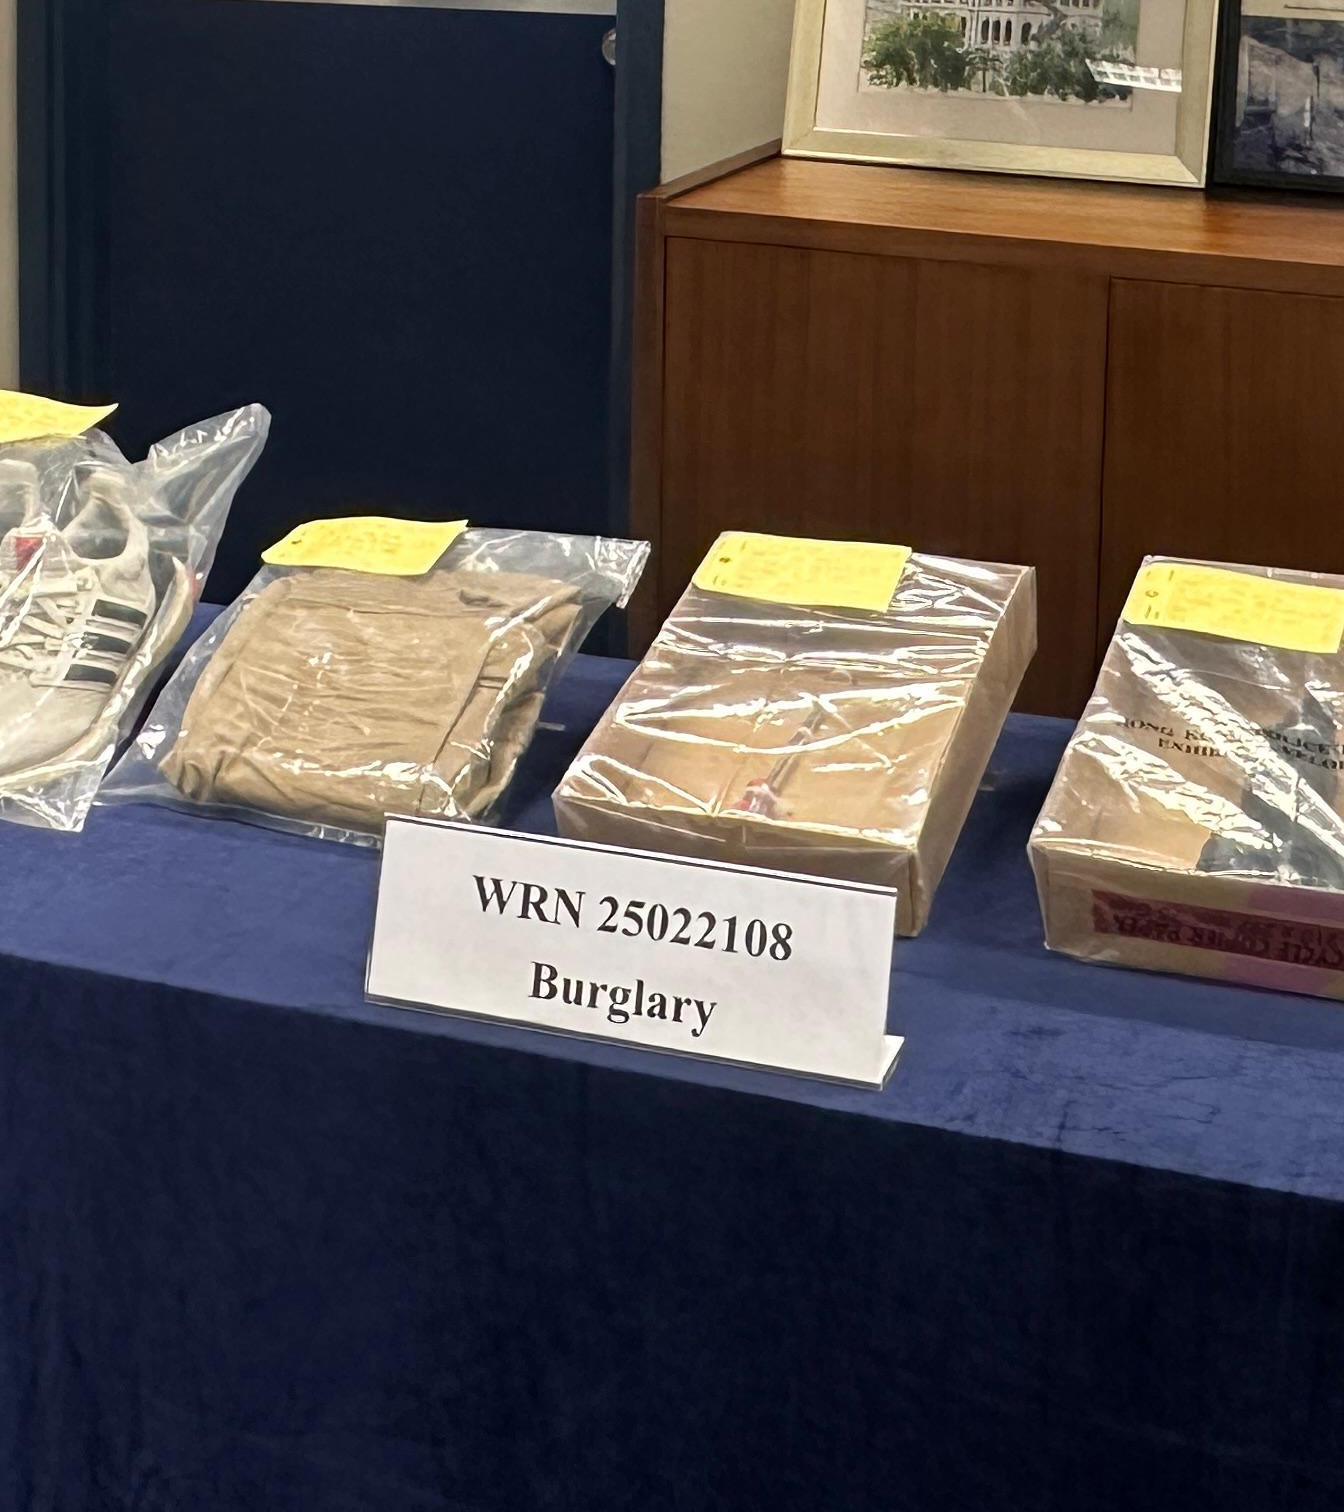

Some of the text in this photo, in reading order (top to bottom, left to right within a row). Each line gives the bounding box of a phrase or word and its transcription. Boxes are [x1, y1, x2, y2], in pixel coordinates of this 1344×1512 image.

[472, 874, 793, 962] WRN 25022108
[529, 960, 718, 1038] Burglary
